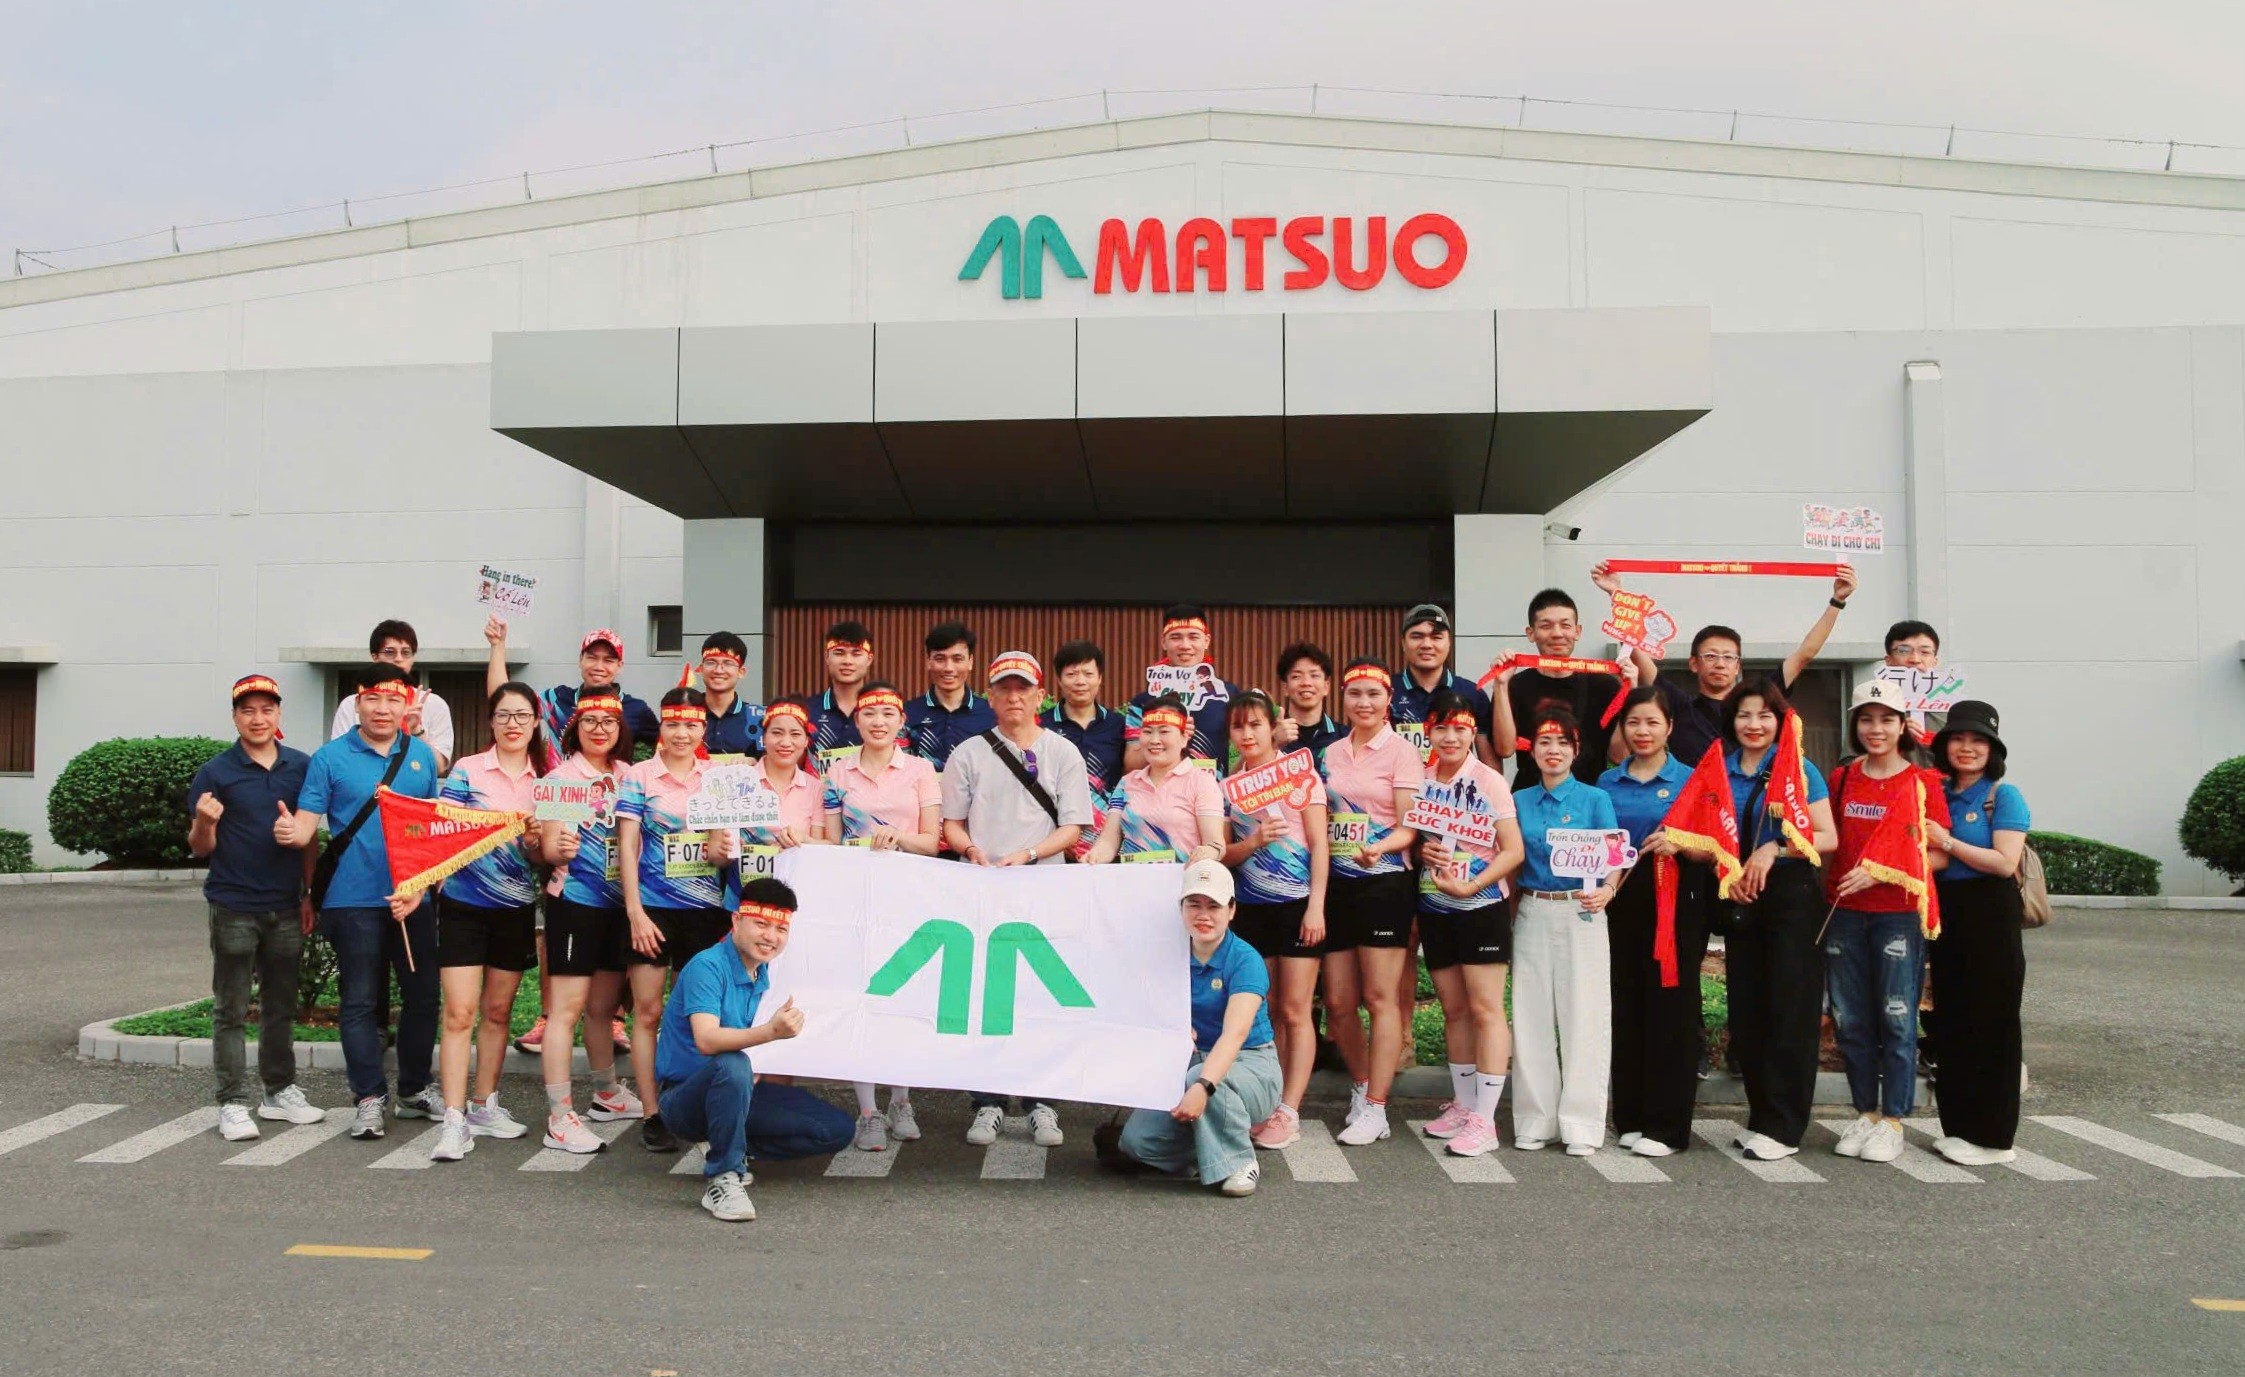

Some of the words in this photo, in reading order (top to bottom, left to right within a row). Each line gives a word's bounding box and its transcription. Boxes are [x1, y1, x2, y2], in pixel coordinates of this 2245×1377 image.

[1094, 212, 1467, 293] MATSUO
[481, 564, 501, 583] Hang
[502, 571, 511, 583] in
[1614, 606, 1641, 620] GIVE
[1614, 618, 1632, 630] UP
[1148, 666, 1172, 679] Trốn
[1176, 670, 1191, 684] Vợ
[1230, 783, 1238, 800] I
[1237, 766, 1278, 797] TRUST
[1279, 752, 1308, 778] YOU
[560, 786, 588, 803] XINH
[1847, 801, 1884, 817] Smile
[1552, 847, 1601, 874] Chạy
